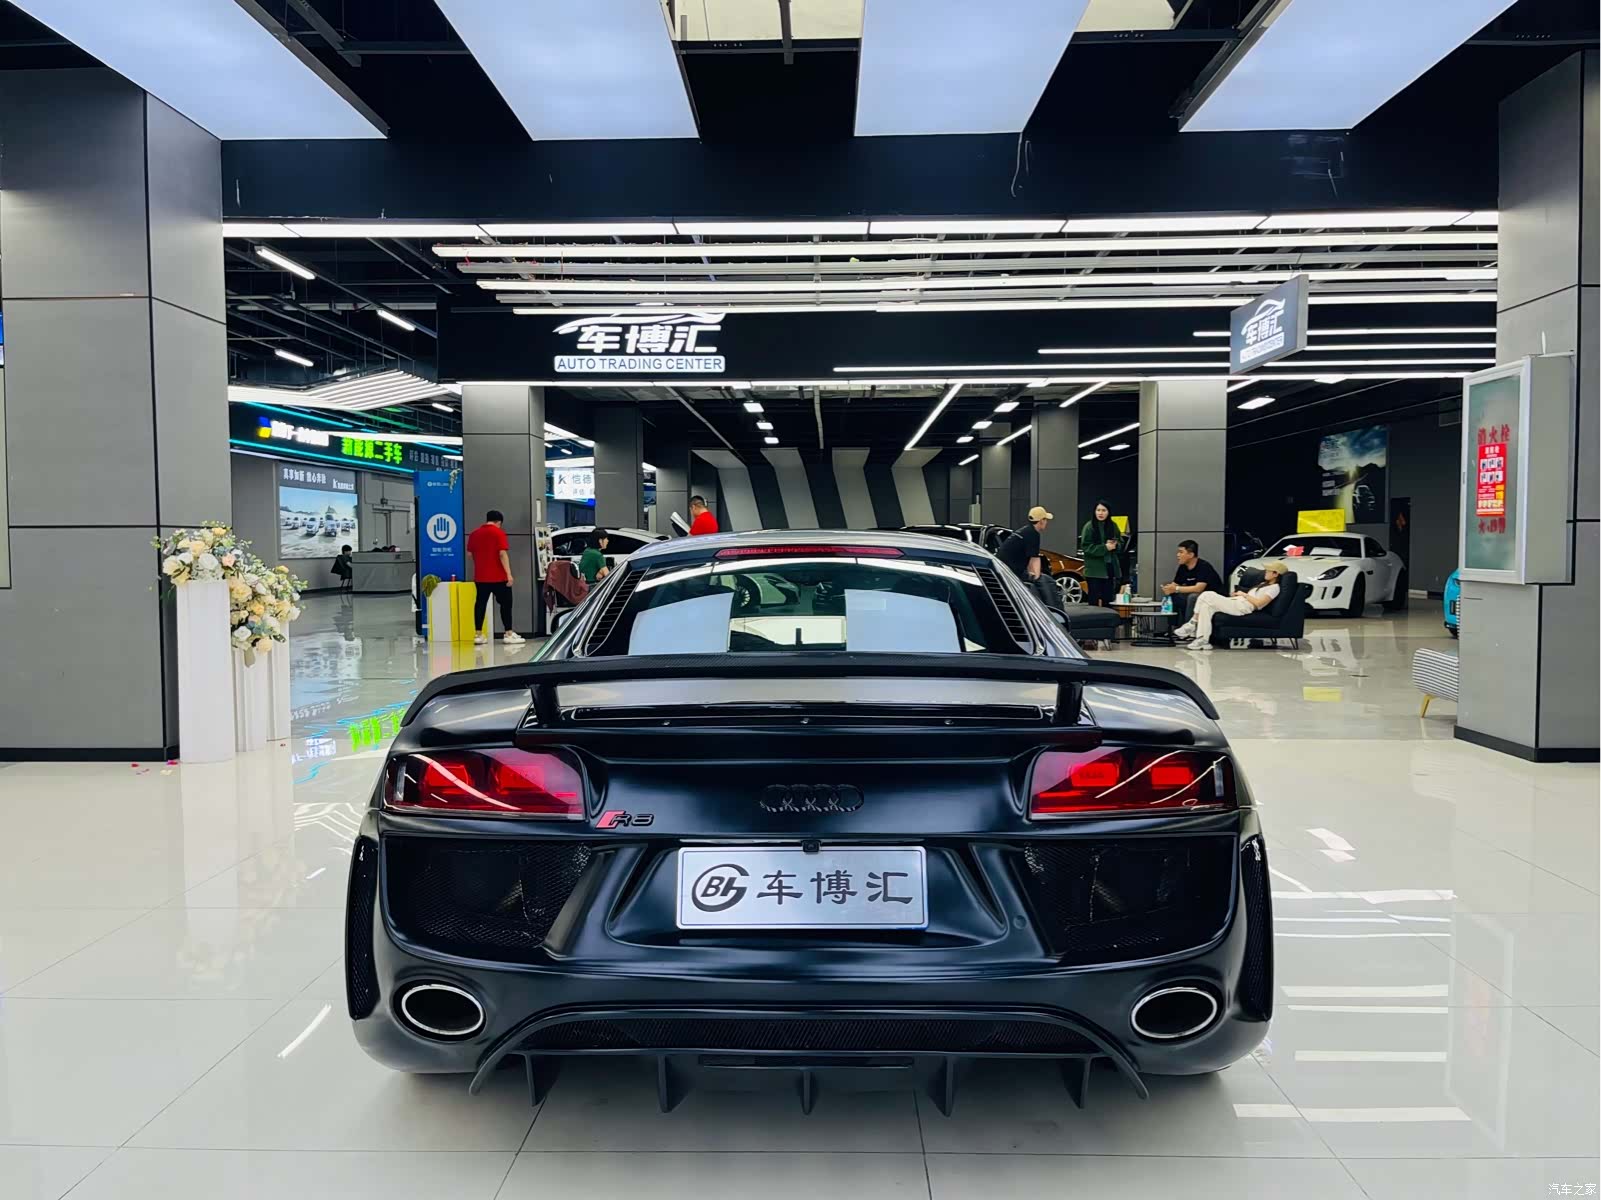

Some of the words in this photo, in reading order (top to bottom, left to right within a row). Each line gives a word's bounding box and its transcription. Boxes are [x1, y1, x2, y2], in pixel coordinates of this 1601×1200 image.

[576, 325, 722, 354] 车博汇
[1246, 310, 1284, 345] 车博汇
[557, 358, 596, 370] AUTO
[599, 358, 662, 370] TRADING
[665, 358, 722, 370] CENTER
[341, 436, 402, 464] 新能源二手车
[757, 869, 913, 905] 车博汇
